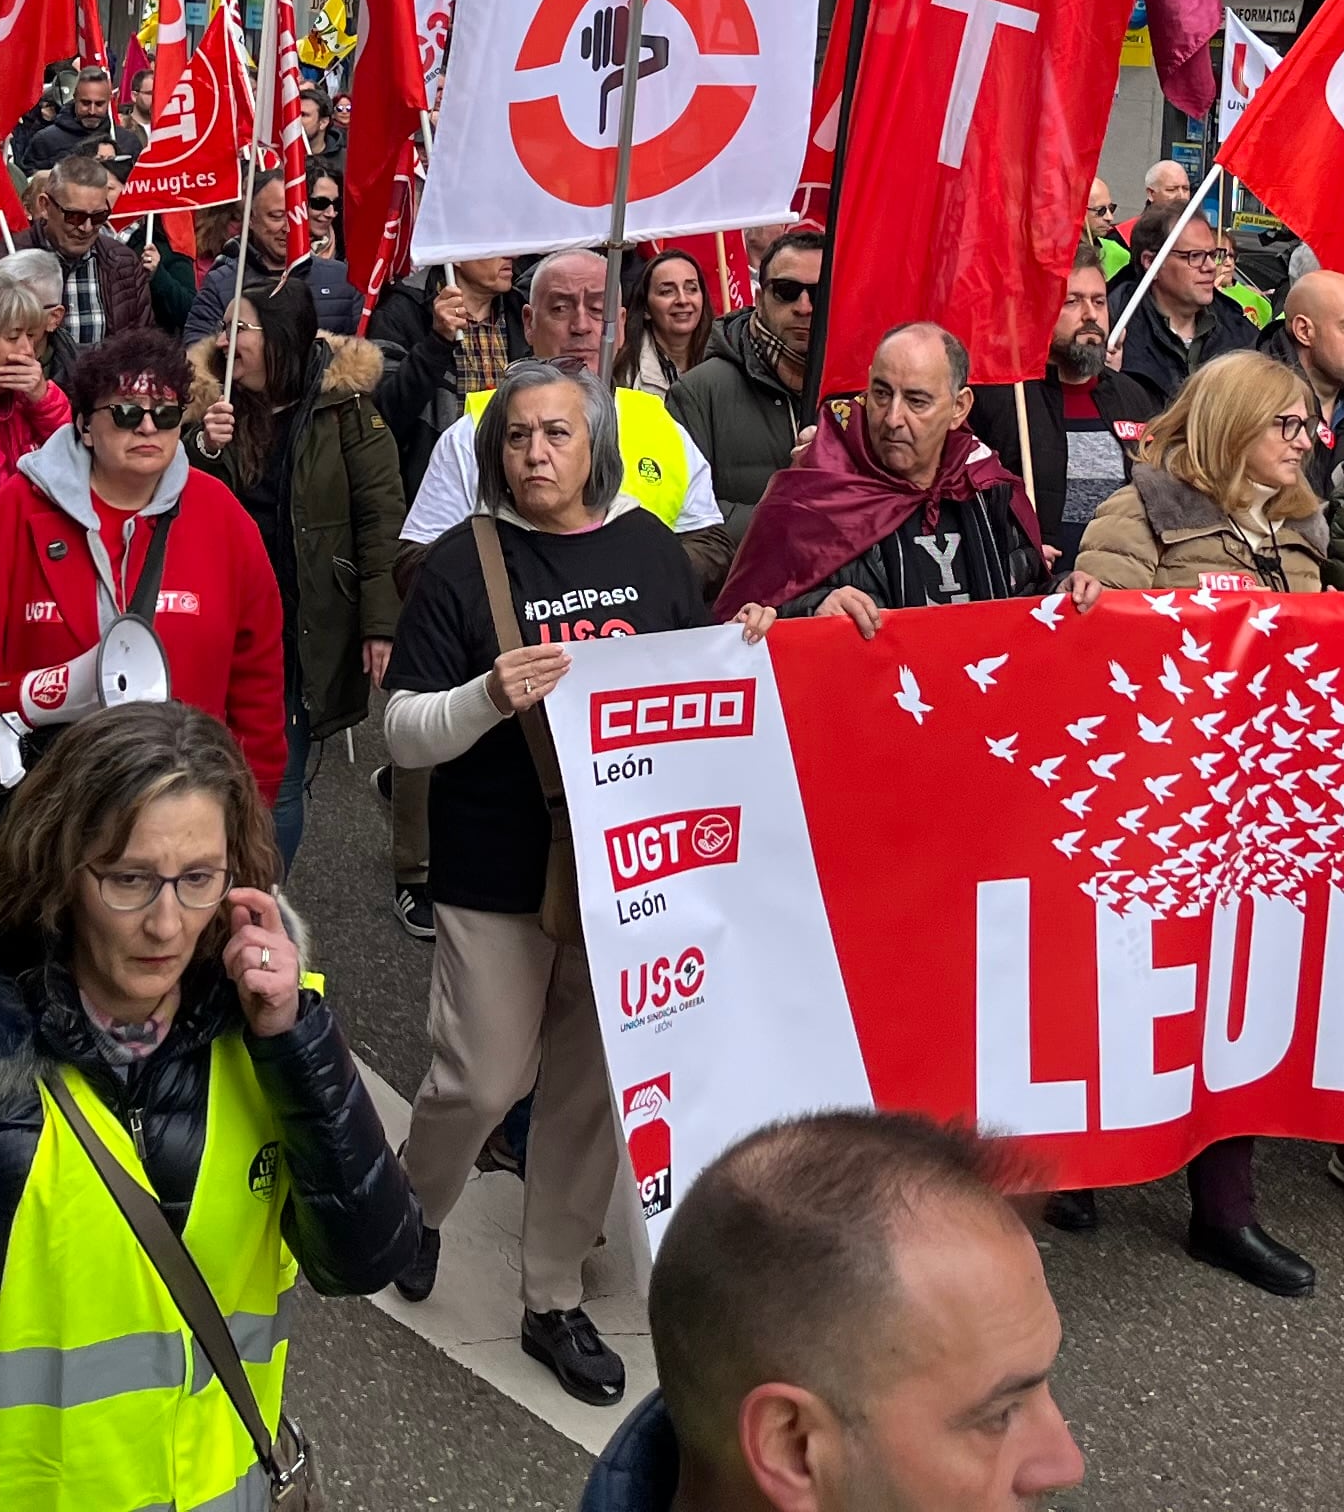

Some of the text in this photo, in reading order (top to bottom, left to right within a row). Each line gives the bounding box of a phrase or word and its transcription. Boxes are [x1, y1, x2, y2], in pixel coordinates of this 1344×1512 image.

[26, 601, 57, 622] UGT
[524, 586, 639, 621] #DaElPaso
[32, 666, 69, 692] UGT
[600, 691, 742, 740] CCOO
[593, 753, 653, 786] León
[612, 819, 686, 880] UGT
[617, 891, 667, 926] León
[620, 945, 705, 1017] USO
[647, 1004, 678, 1024] SINDICAL
[637, 1168, 669, 1203] GT
